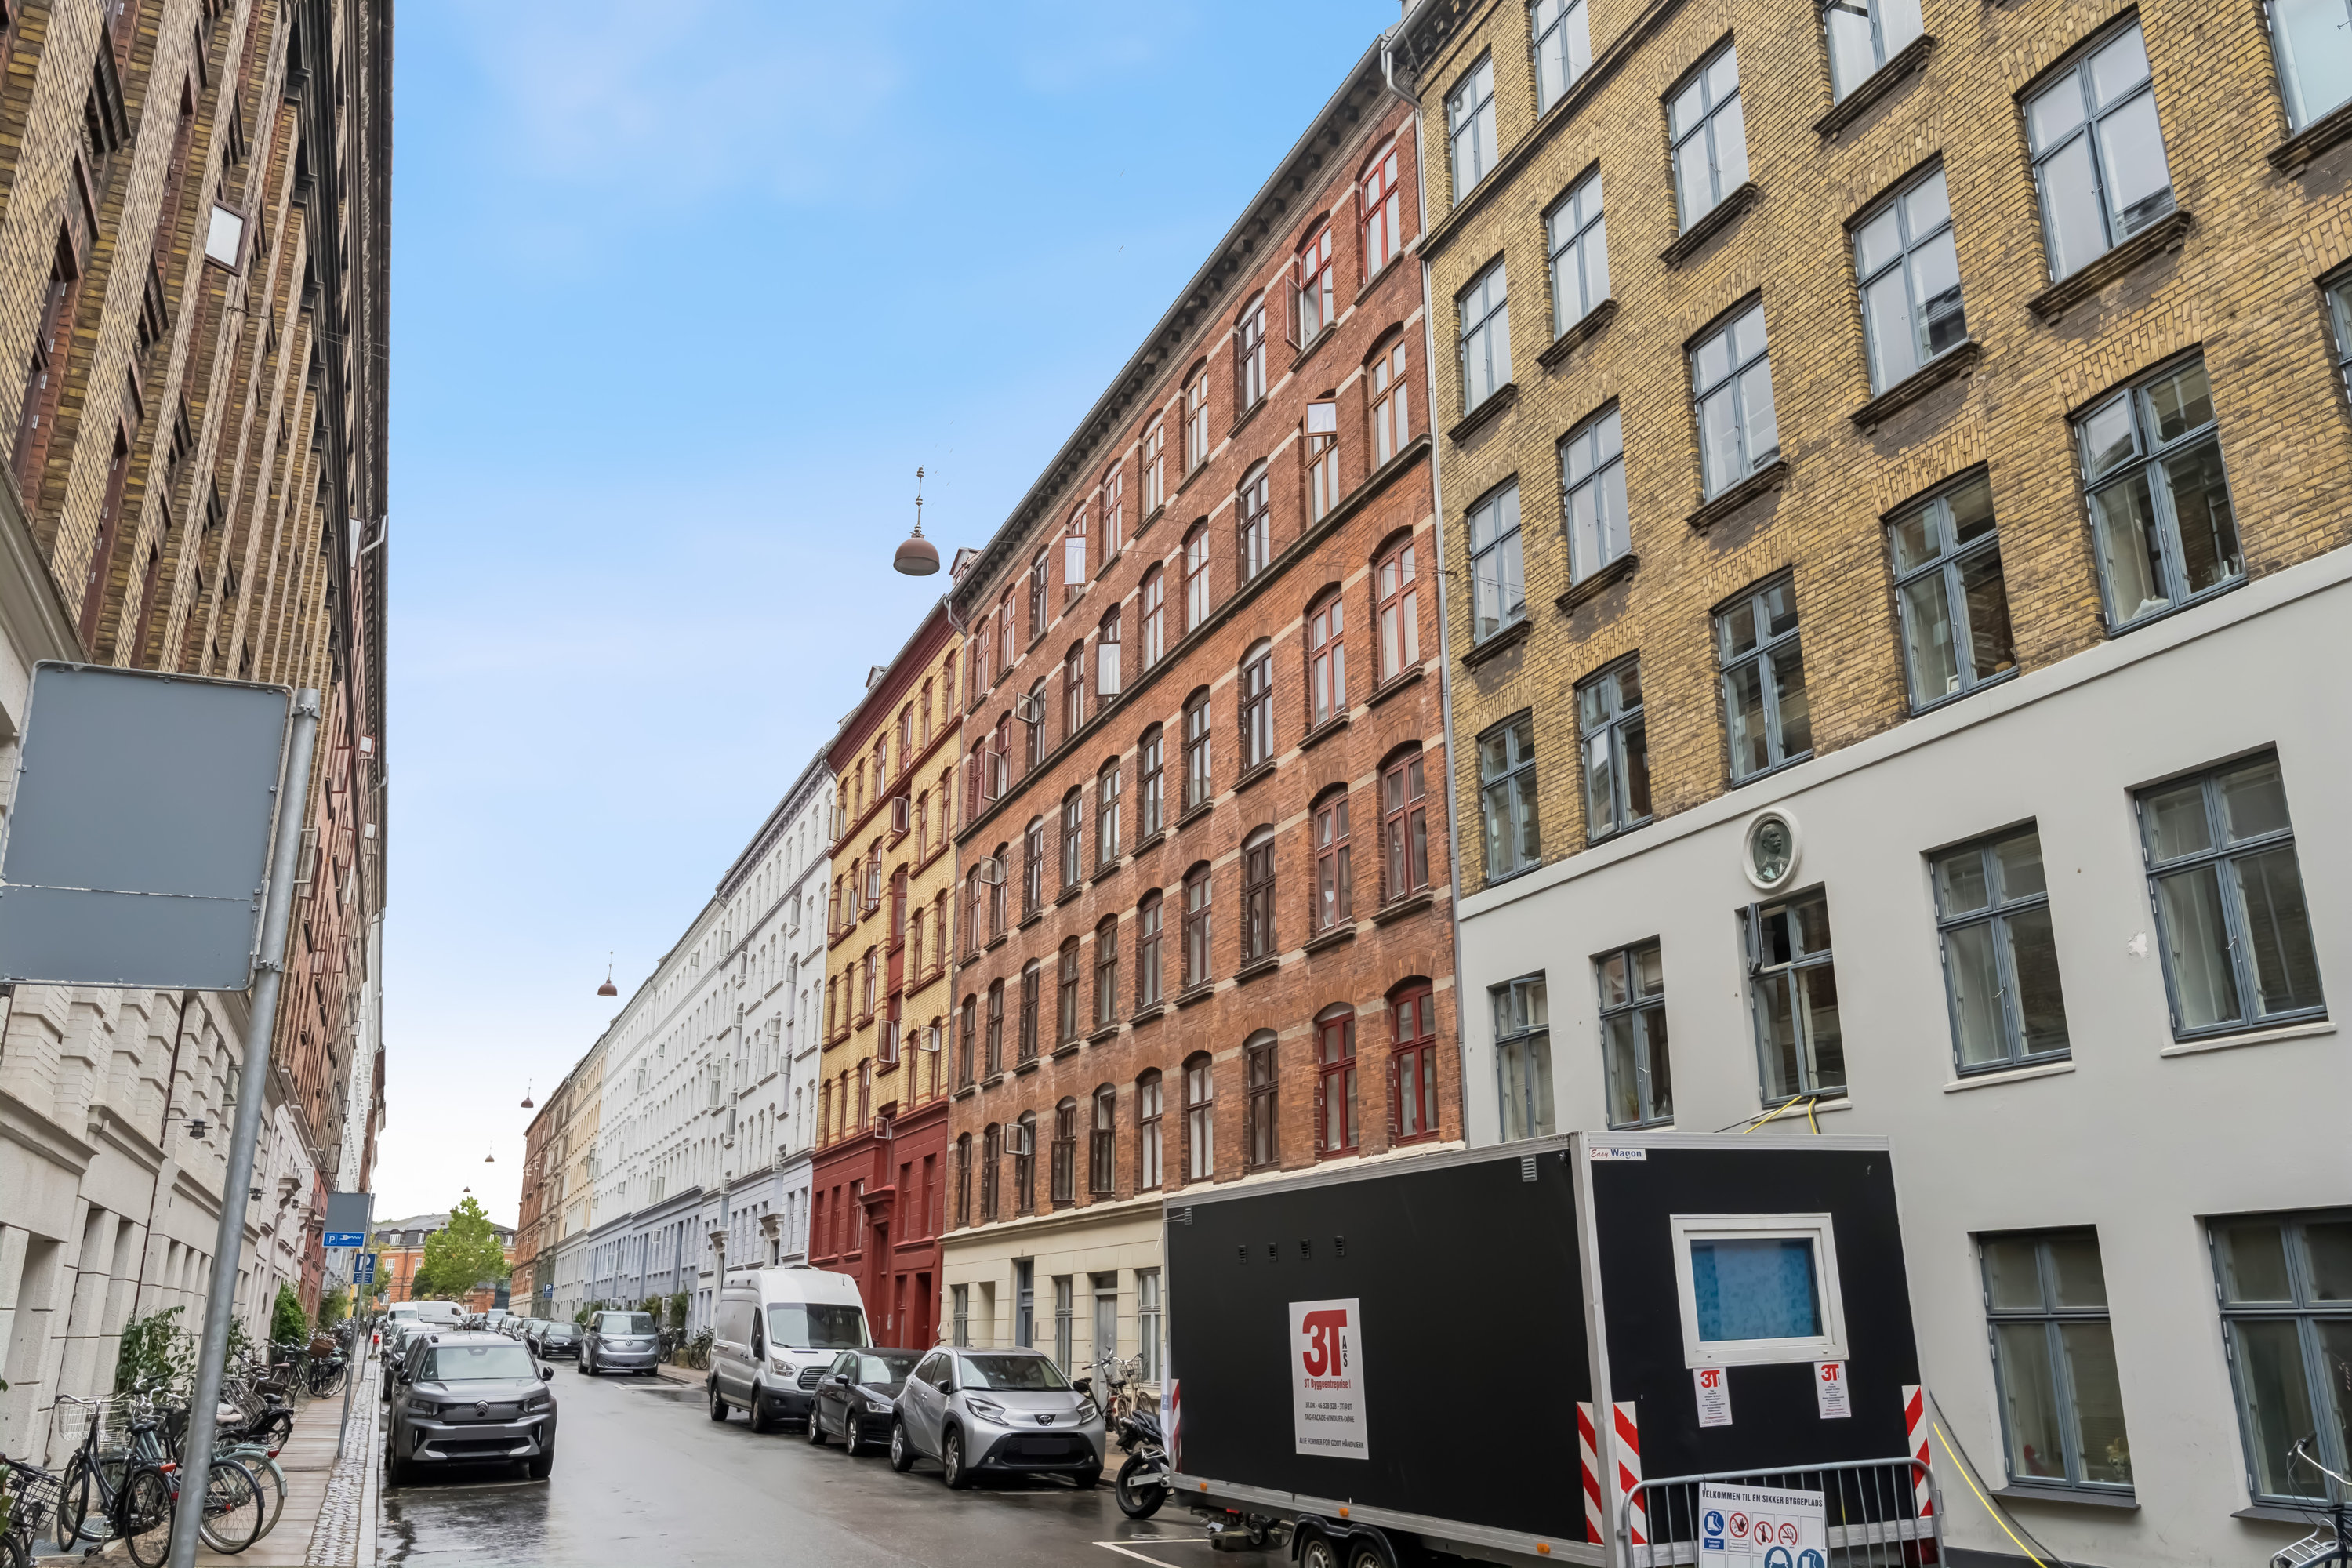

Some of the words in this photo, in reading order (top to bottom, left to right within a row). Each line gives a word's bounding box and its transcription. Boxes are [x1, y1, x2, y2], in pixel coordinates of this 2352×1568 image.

[1591, 1149, 1608, 1159] Easy
[1610, 1149, 1642, 1159] Wagon
[546, 1283, 552, 1292] P
[1302, 1308, 1347, 1377] 3T
[1700, 1370, 1720, 1388] 3T
[1821, 1363, 1839, 1381] 3T
[1304, 1378, 1310, 1388] 3T
[1311, 1378, 1348, 1391] Byggeentreprise
[1342, 1439, 1364, 1449] HÅNDVÆRK
[1702, 1490, 1740, 1501] VELKOMMEN
[1742, 1493, 1751, 1502] TIL
[1752, 1494, 1761, 1503] EN
[1762, 1495, 1784, 1504] SIKKER
[1785, 1497, 1823, 1508] BYGGEPLADS
